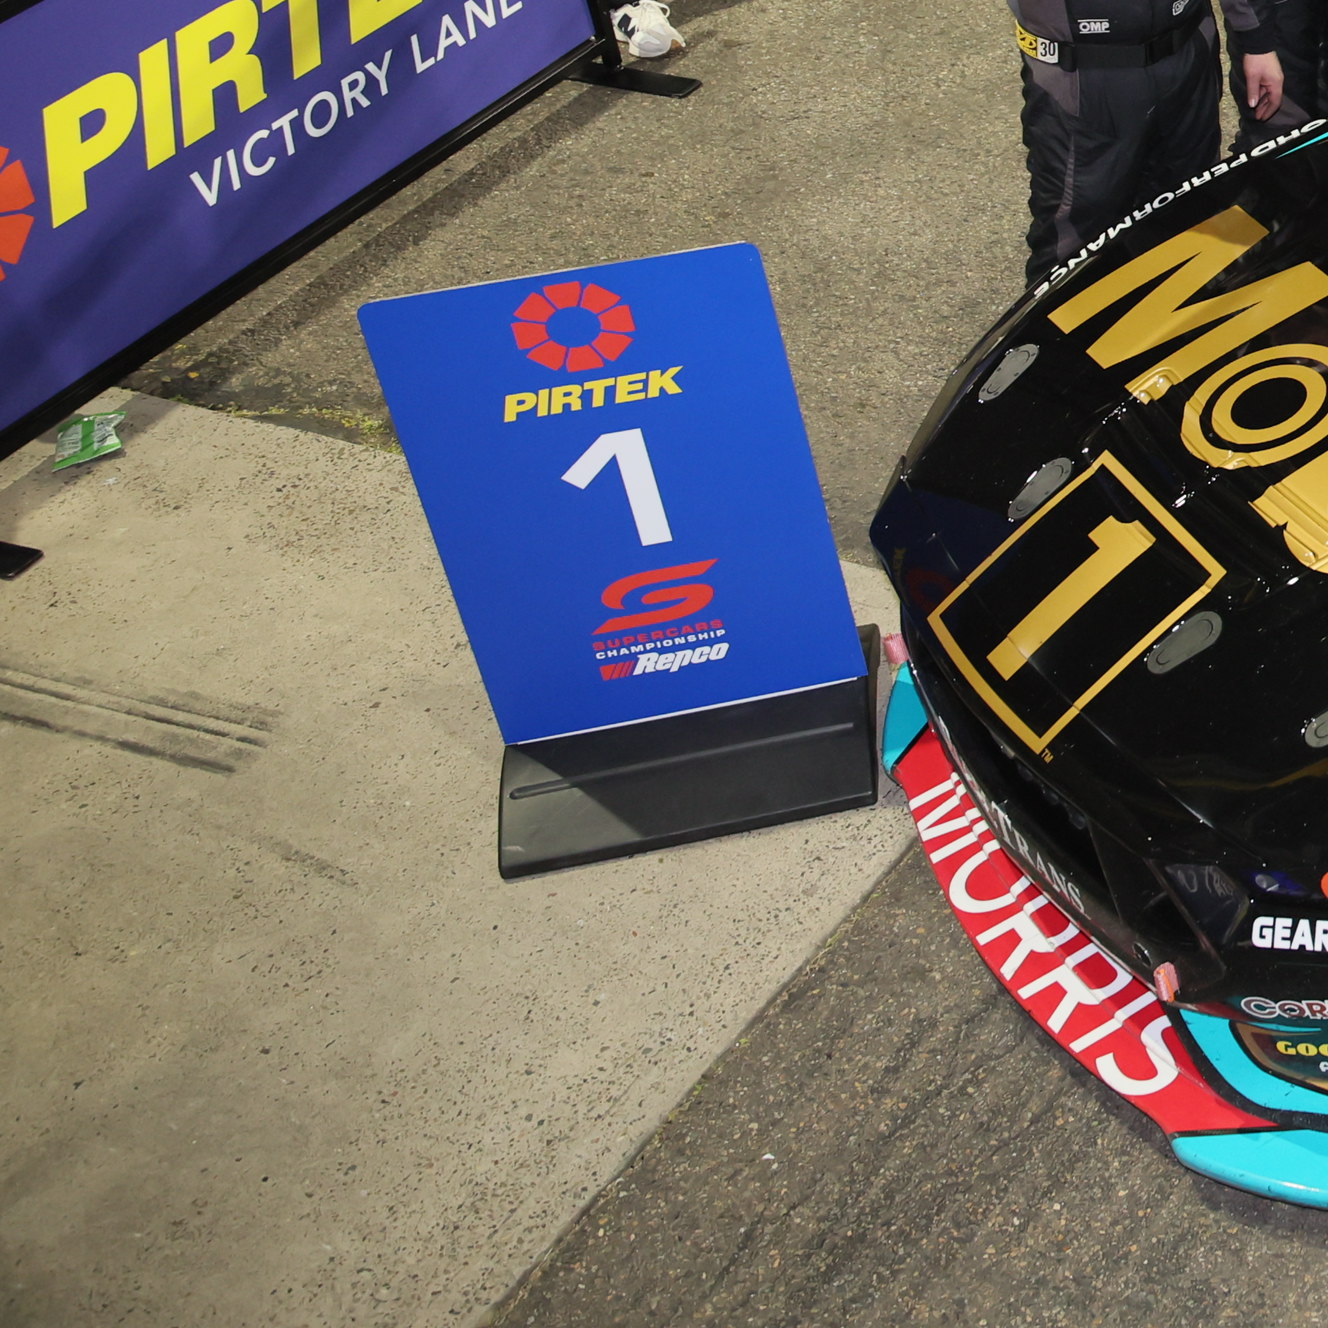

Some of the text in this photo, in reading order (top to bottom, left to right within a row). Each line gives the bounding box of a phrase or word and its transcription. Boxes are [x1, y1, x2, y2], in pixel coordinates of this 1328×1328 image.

[1079, 21, 1110, 33] OMP
[189, 49, 394, 208] VICTORY
[504, 365, 683, 423] PIRTEK
[561, 428, 673, 547] 1
[986, 514, 1157, 680] 1
[592, 619, 724, 652] SUPERCARS
[595, 629, 727, 661] CHAMPIONSHIP
[633, 641, 729, 676] Repco
[909, 776, 1180, 1096] MORRIS
